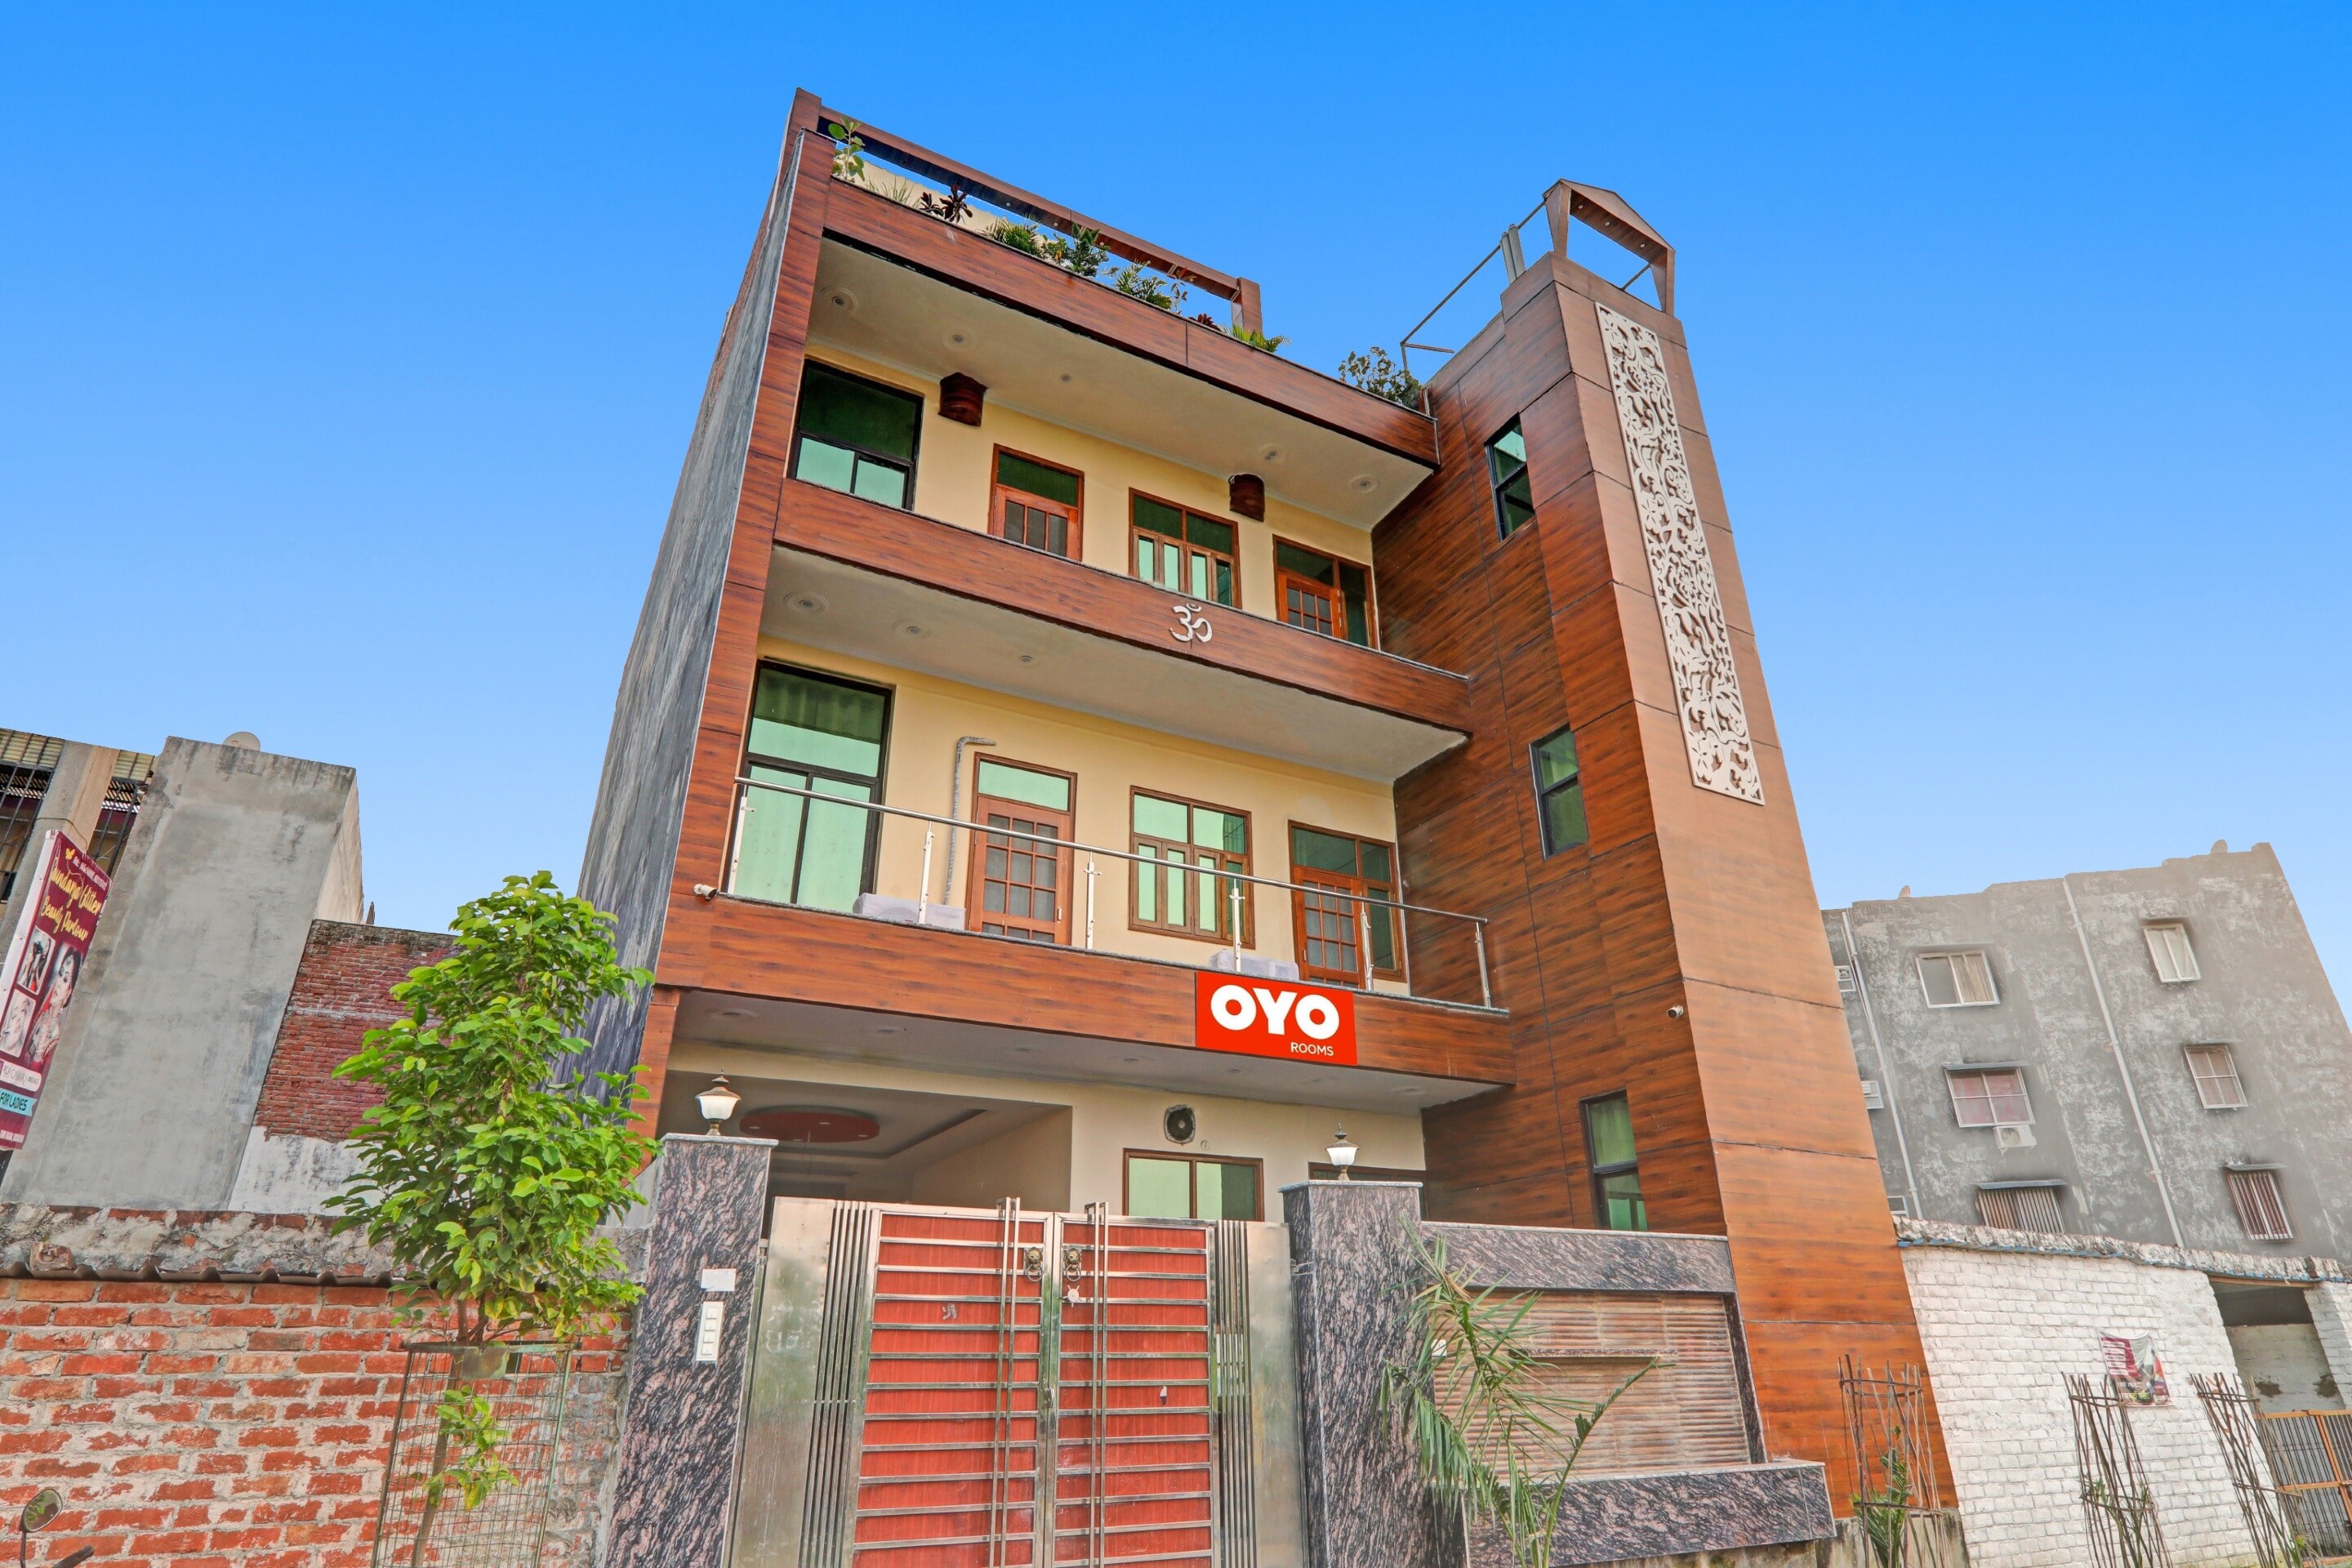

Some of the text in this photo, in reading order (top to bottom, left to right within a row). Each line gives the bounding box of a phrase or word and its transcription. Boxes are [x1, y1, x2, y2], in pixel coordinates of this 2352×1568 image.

[42, 896, 64, 933] Beauty
[1210, 984, 1340, 1040] OYO
[1290, 1041, 1334, 1057] ROOMS
[9, 1095, 28, 1111] LADIES
